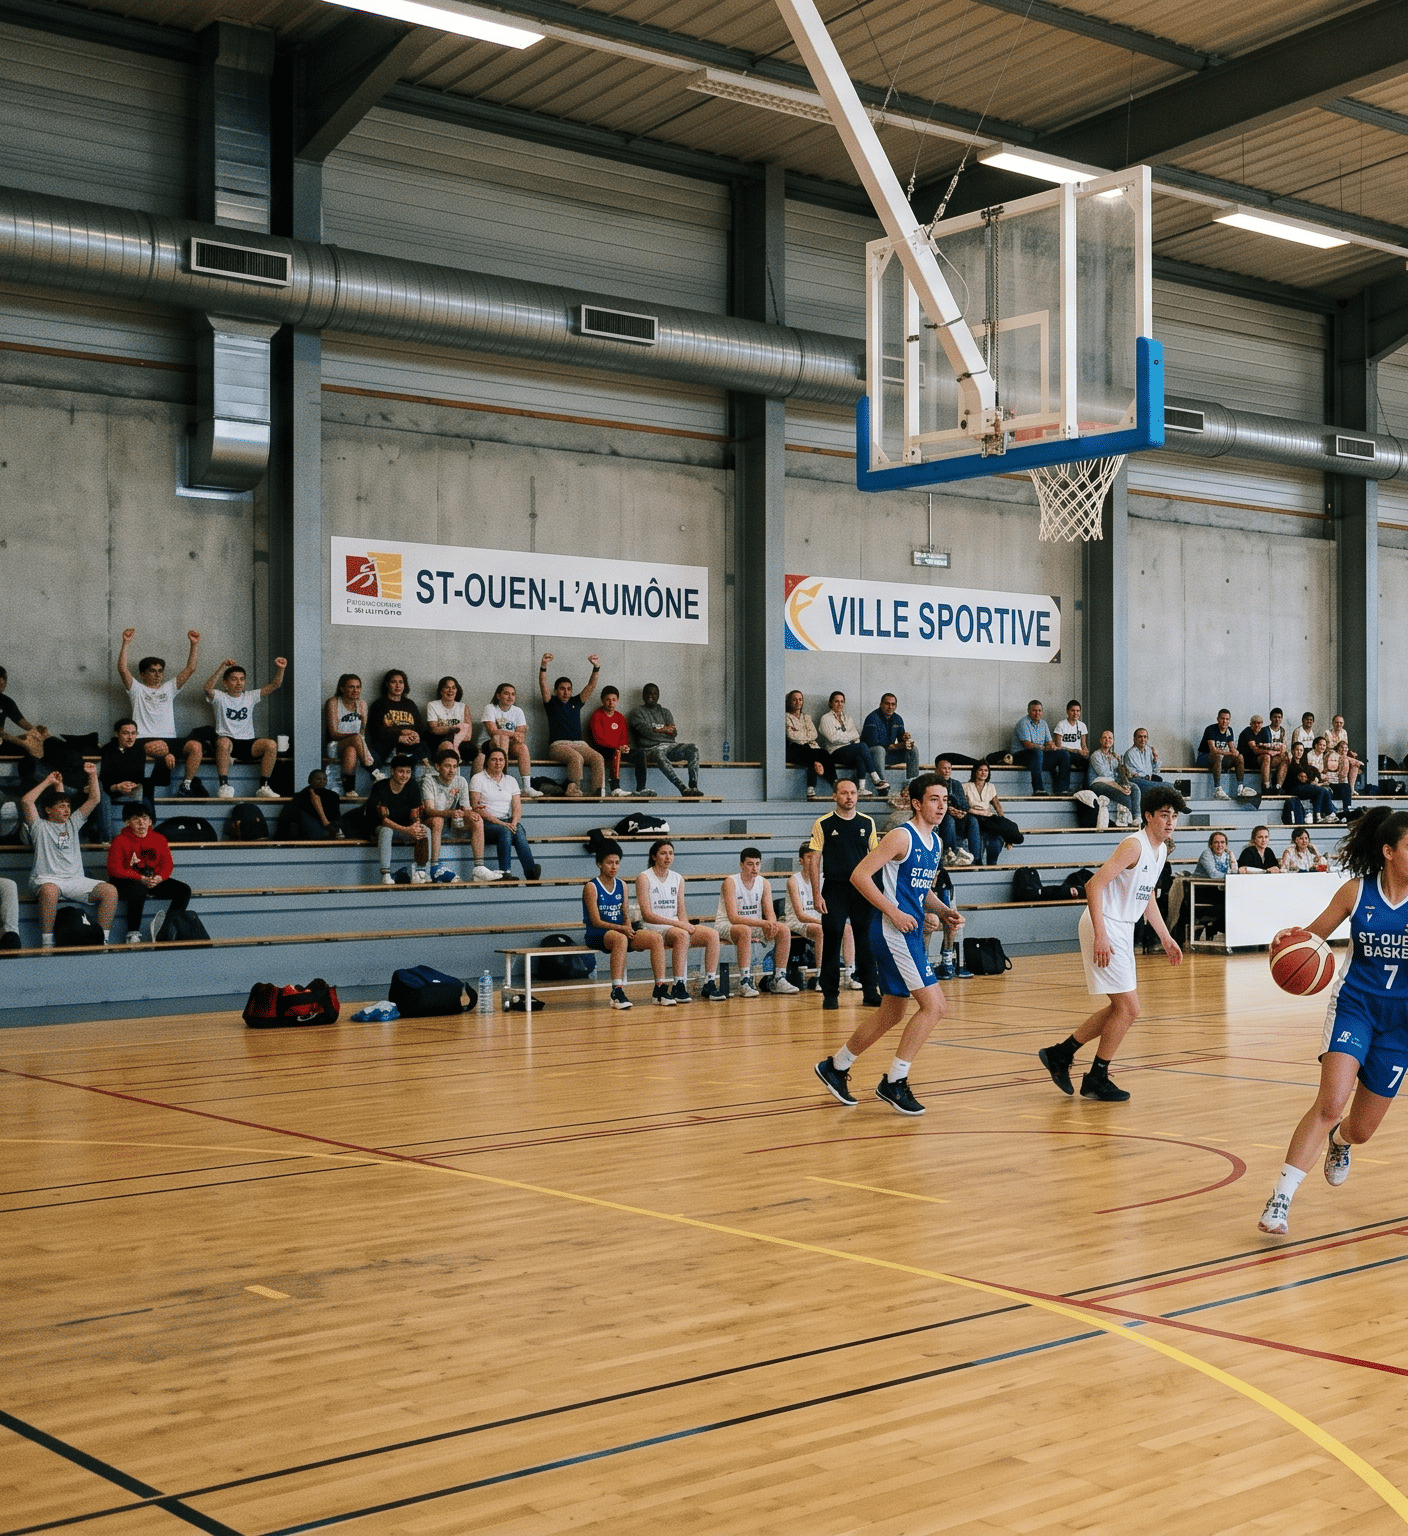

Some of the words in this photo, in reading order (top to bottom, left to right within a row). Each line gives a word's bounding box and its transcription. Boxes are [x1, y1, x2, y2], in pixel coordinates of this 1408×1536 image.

[416, 569, 699, 620] ST-OUEN-L'AUMÔNE
[828, 595, 909, 639] VILLE
[919, 601, 1051, 647] SPORTIVE
[1384, 965, 1398, 990] 7
[1387, 1065, 1404, 1089] 7
